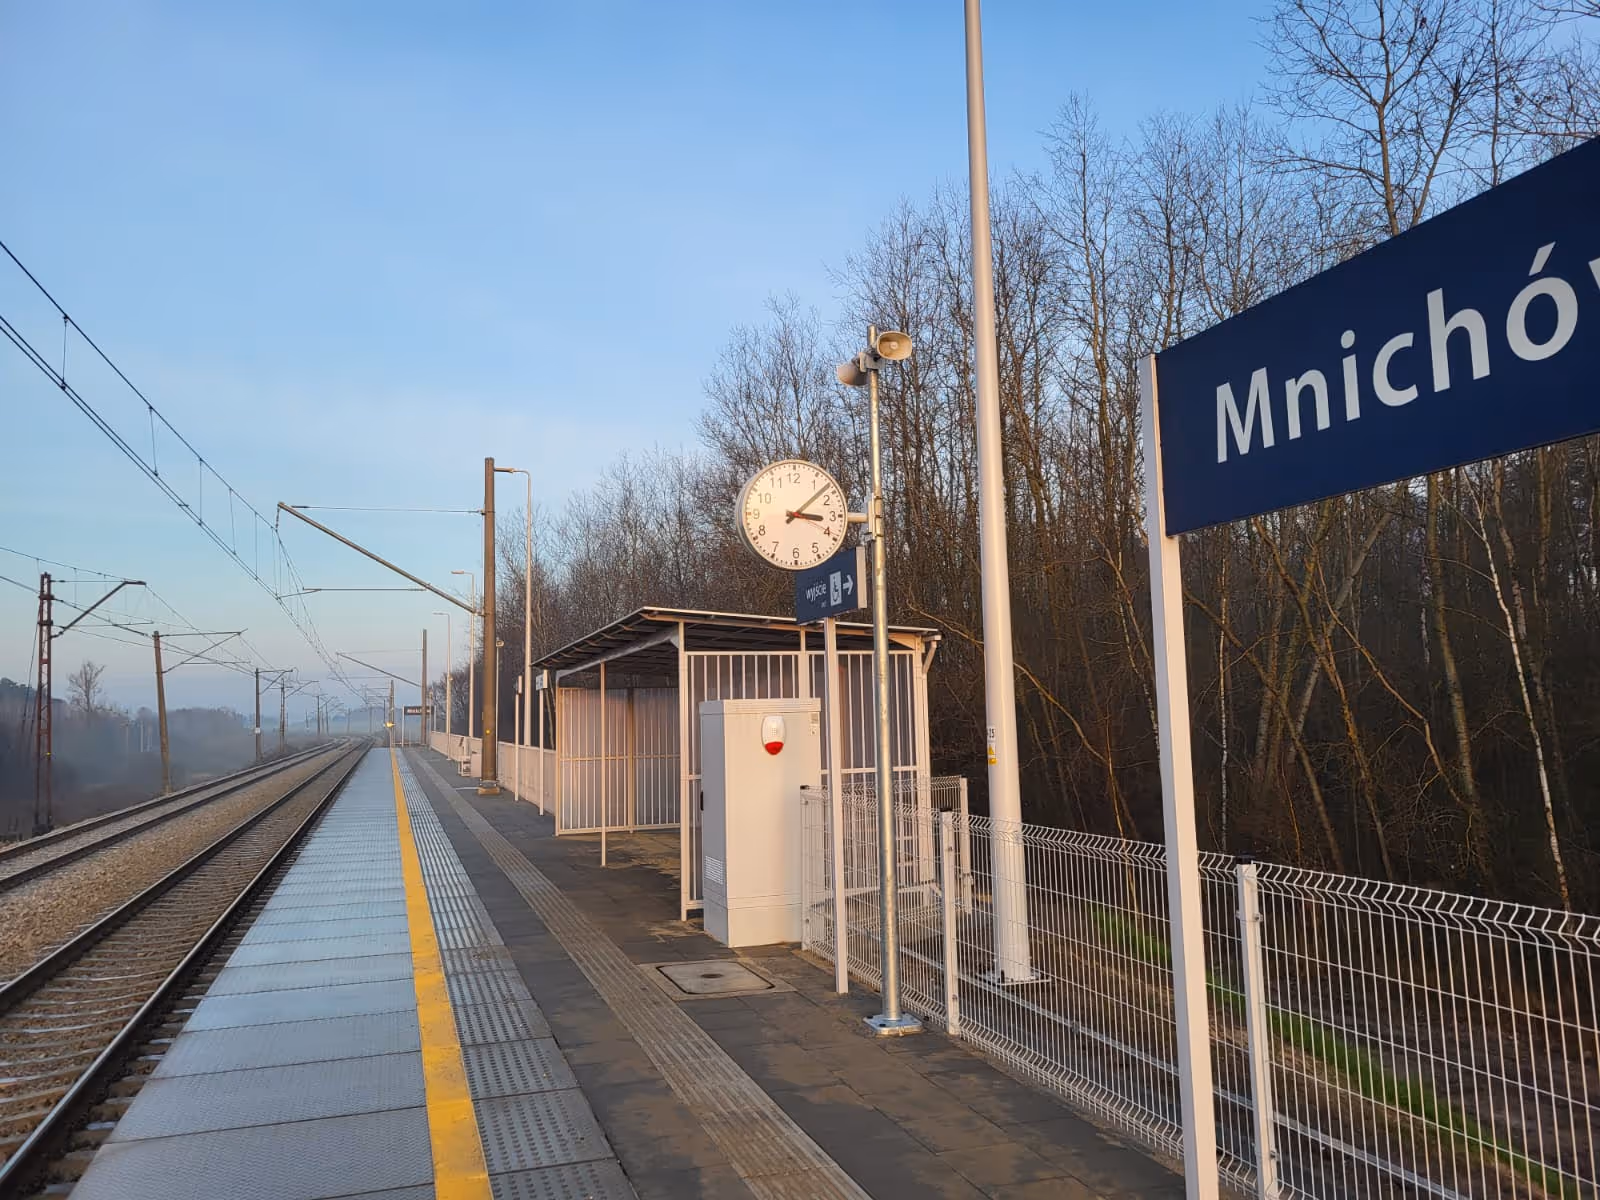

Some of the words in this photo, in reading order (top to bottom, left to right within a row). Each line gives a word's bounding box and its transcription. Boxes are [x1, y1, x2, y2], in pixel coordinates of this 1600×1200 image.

[1216, 241, 1600, 464] Mnichó
[771, 478, 782, 488] 11
[787, 473, 800, 484] 12
[758, 493, 771, 504] 10
[823, 495, 830, 506] 2
[753, 509, 760, 520] 9
[829, 511, 836, 522] 3
[758, 525, 766, 536] 8
[824, 526, 831, 537] 4
[772, 541, 779, 552] 7
[811, 542, 819, 554] 5
[792, 547, 800, 559] 6
